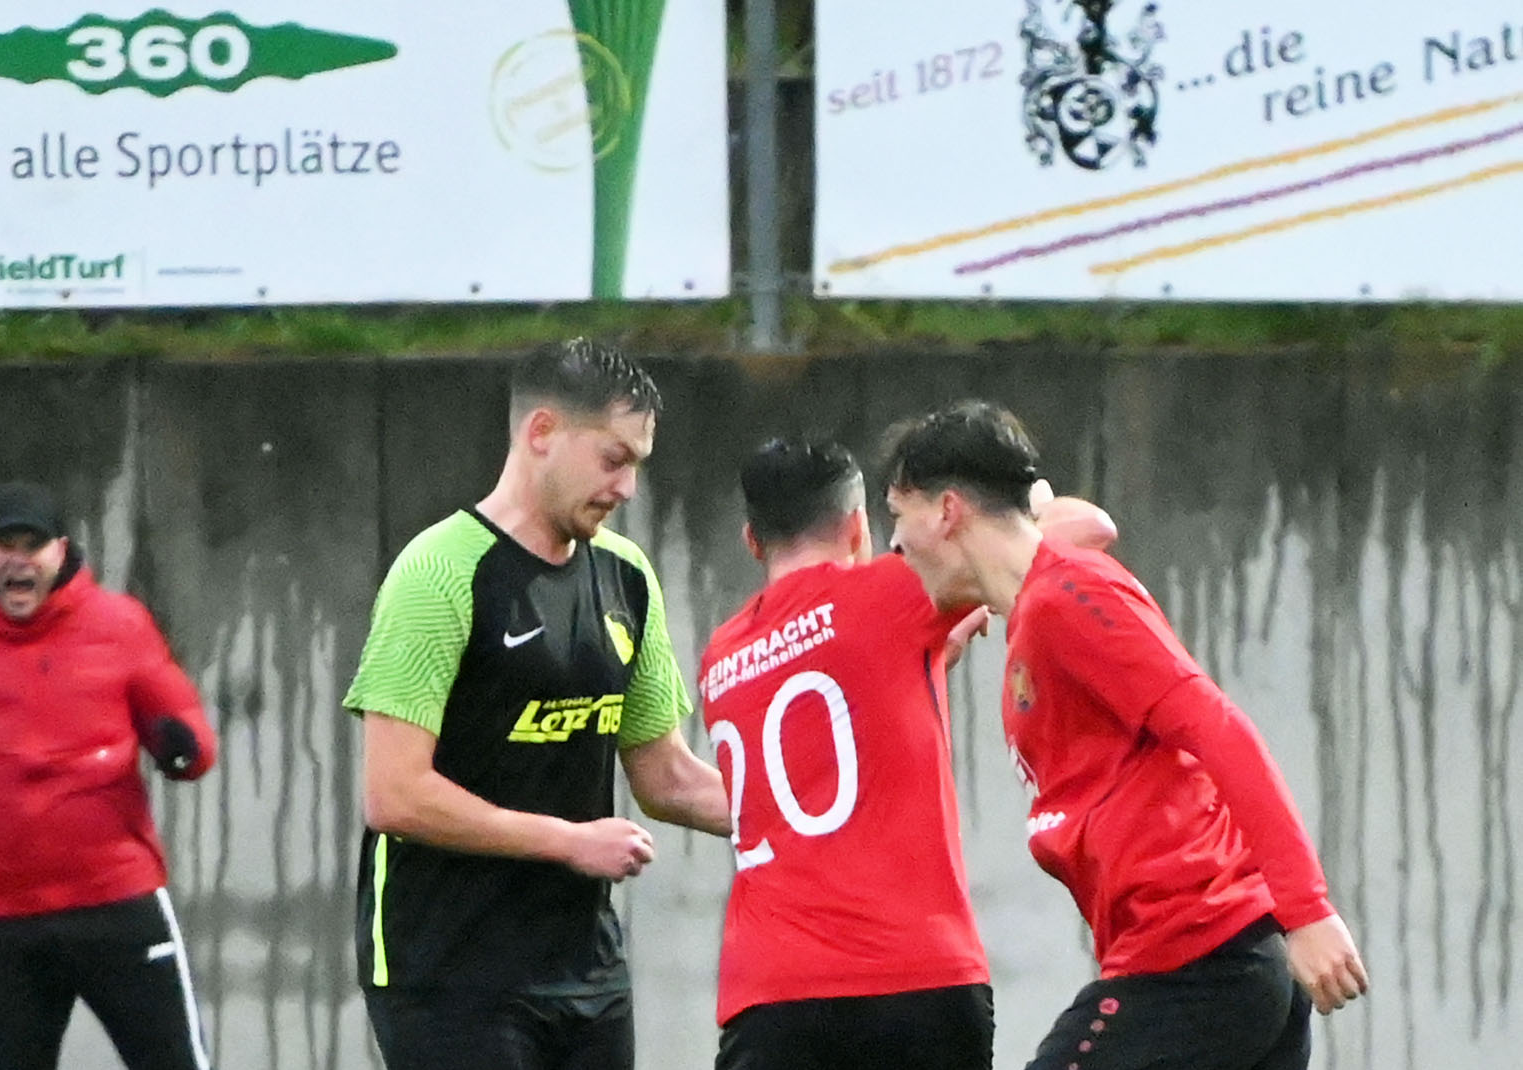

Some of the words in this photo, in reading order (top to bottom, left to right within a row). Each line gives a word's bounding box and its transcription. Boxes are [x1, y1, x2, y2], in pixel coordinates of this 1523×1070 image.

[66, 25, 251, 81] 360
[827, 70, 901, 114] seit
[916, 41, 1004, 94] 1872
[1262, 60, 1397, 122] reine
[1423, 22, 1523, 84] Nat
[11, 133, 100, 179] alle
[117, 129, 401, 188] Sportplätze
[708, 602, 834, 688] EINTRACHT
[709, 670, 859, 873] 20
